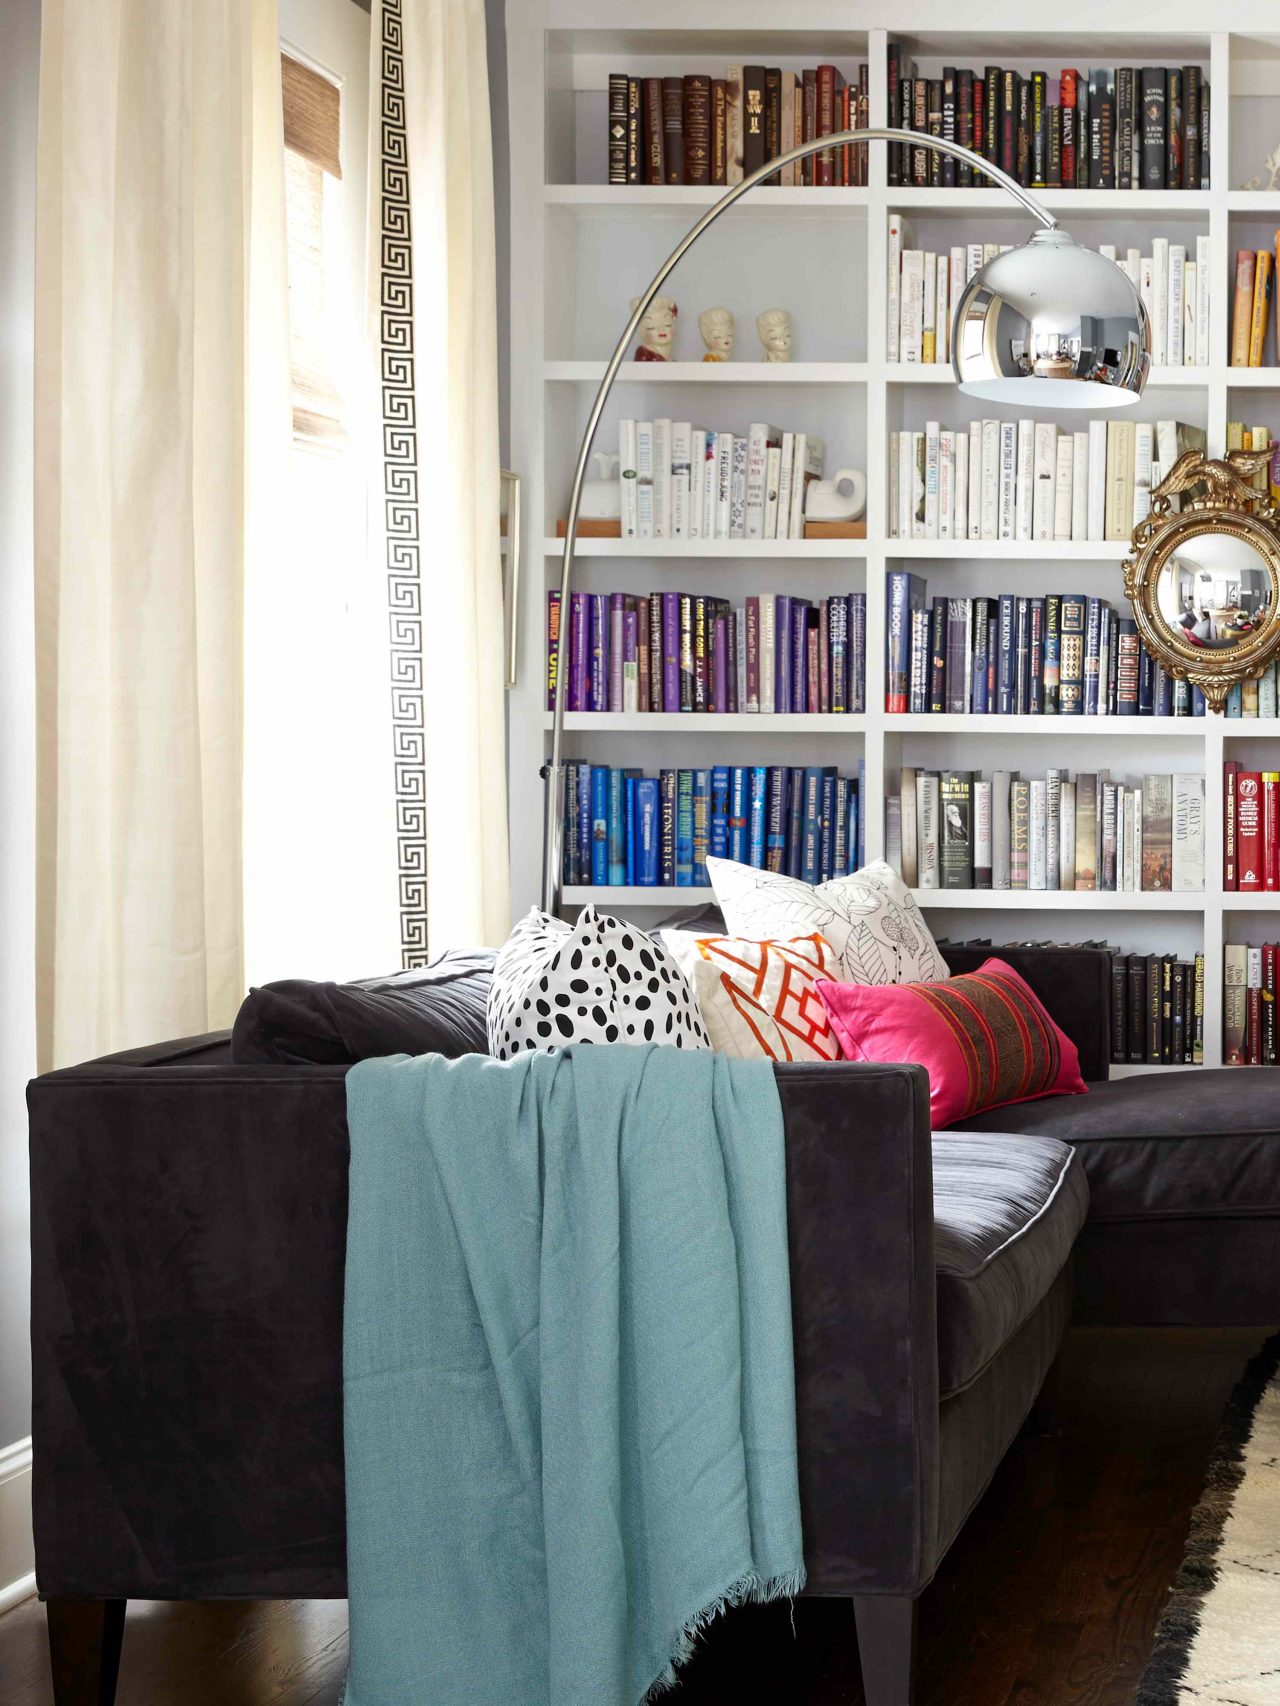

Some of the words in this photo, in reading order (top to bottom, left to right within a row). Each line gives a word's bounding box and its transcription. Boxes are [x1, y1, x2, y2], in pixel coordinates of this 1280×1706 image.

[551, 602, 560, 640] EVANOVICH
[682, 598, 690, 630] STUART
[830, 604, 839, 642] COULTER
[1003, 601, 1012, 616] ICE
[1049, 598, 1059, 632] FANNIE
[1002, 618, 1010, 650] BOUND
[1048, 633, 1058, 662] FLAGG
[679, 772, 692, 793] JAYNE
[1105, 787, 1115, 814] SANDRA
[664, 803, 672, 832] LEON
[679, 812, 691, 838] KRENTZ
[1018, 786, 1028, 850] POEMS
[1176, 792, 1187, 842] ANATOMY
[1191, 798, 1200, 836] GRAY'S
[664, 836, 672, 867] URIS
[1196, 956, 1204, 982] GERALD
[1195, 983, 1204, 1016] HAMMOND
